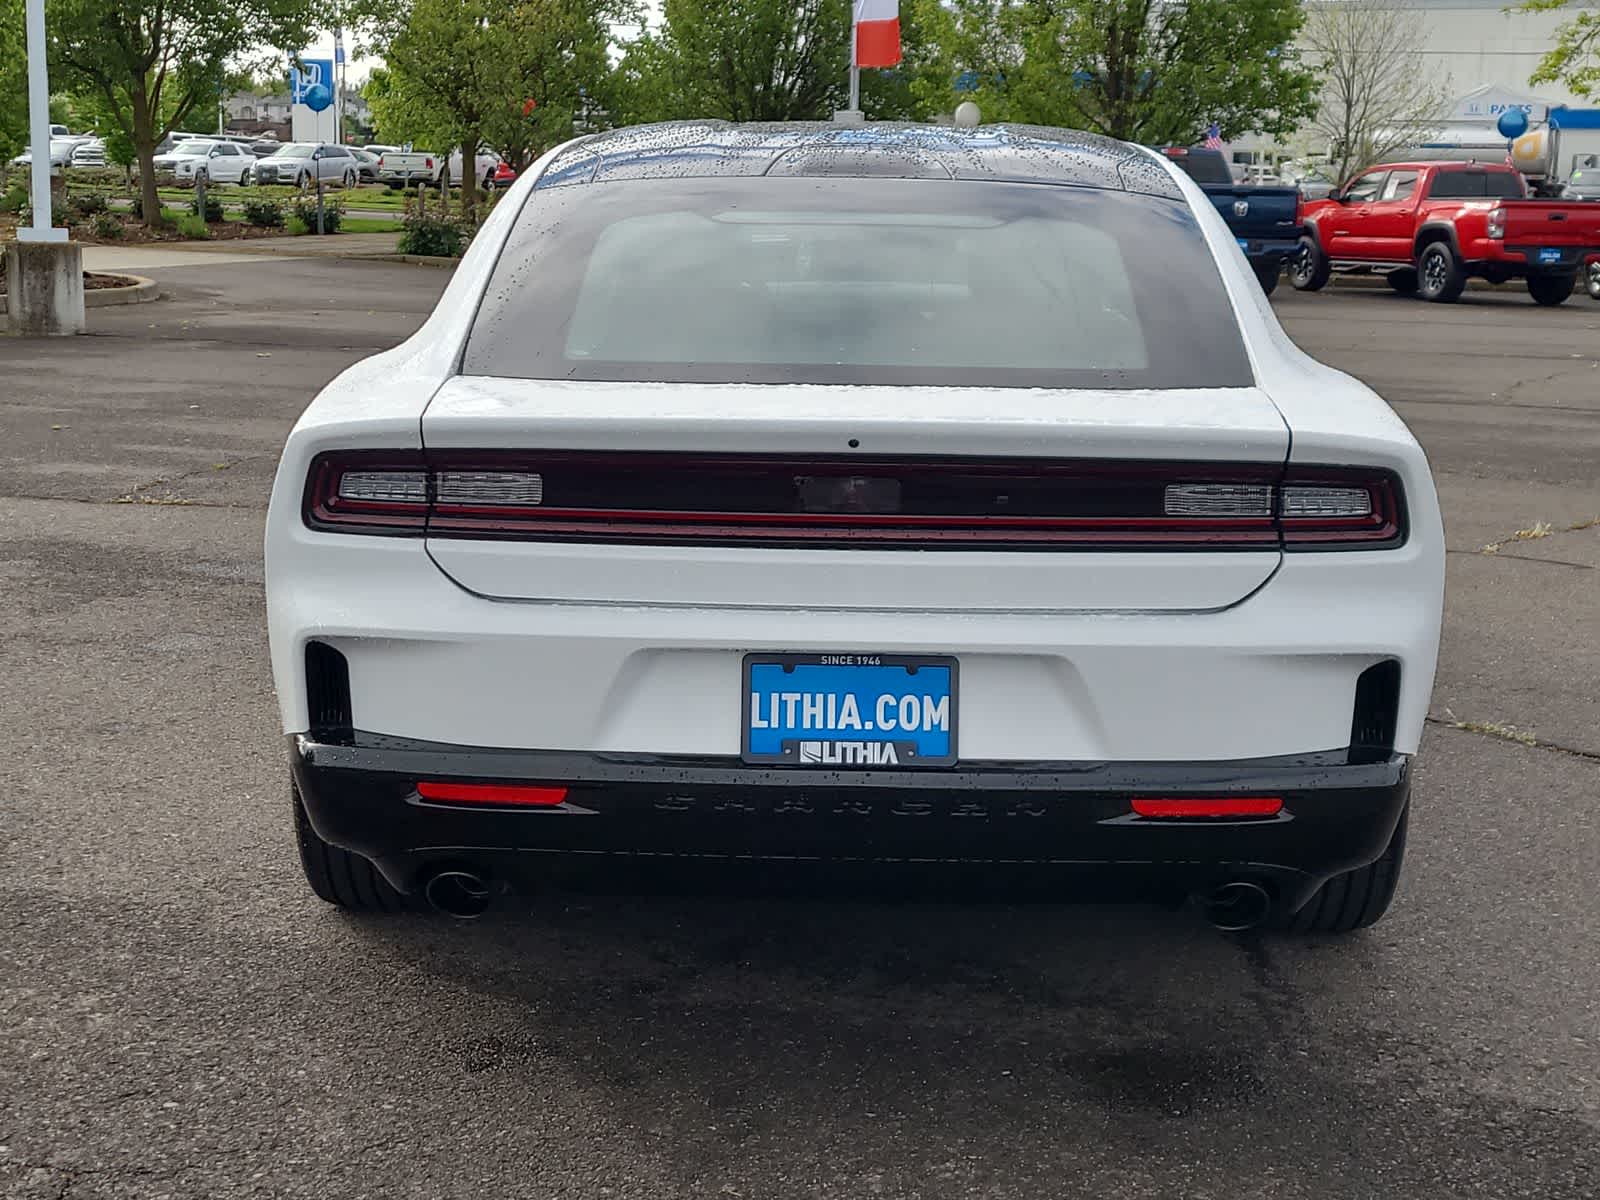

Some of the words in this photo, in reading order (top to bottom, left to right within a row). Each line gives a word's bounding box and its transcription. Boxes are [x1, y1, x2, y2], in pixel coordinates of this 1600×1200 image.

[821, 655, 853, 665] SINCE
[856, 656, 881, 666] 1946
[751, 692, 950, 731] LITHIA.COM
[821, 741, 899, 764] LITHIA
